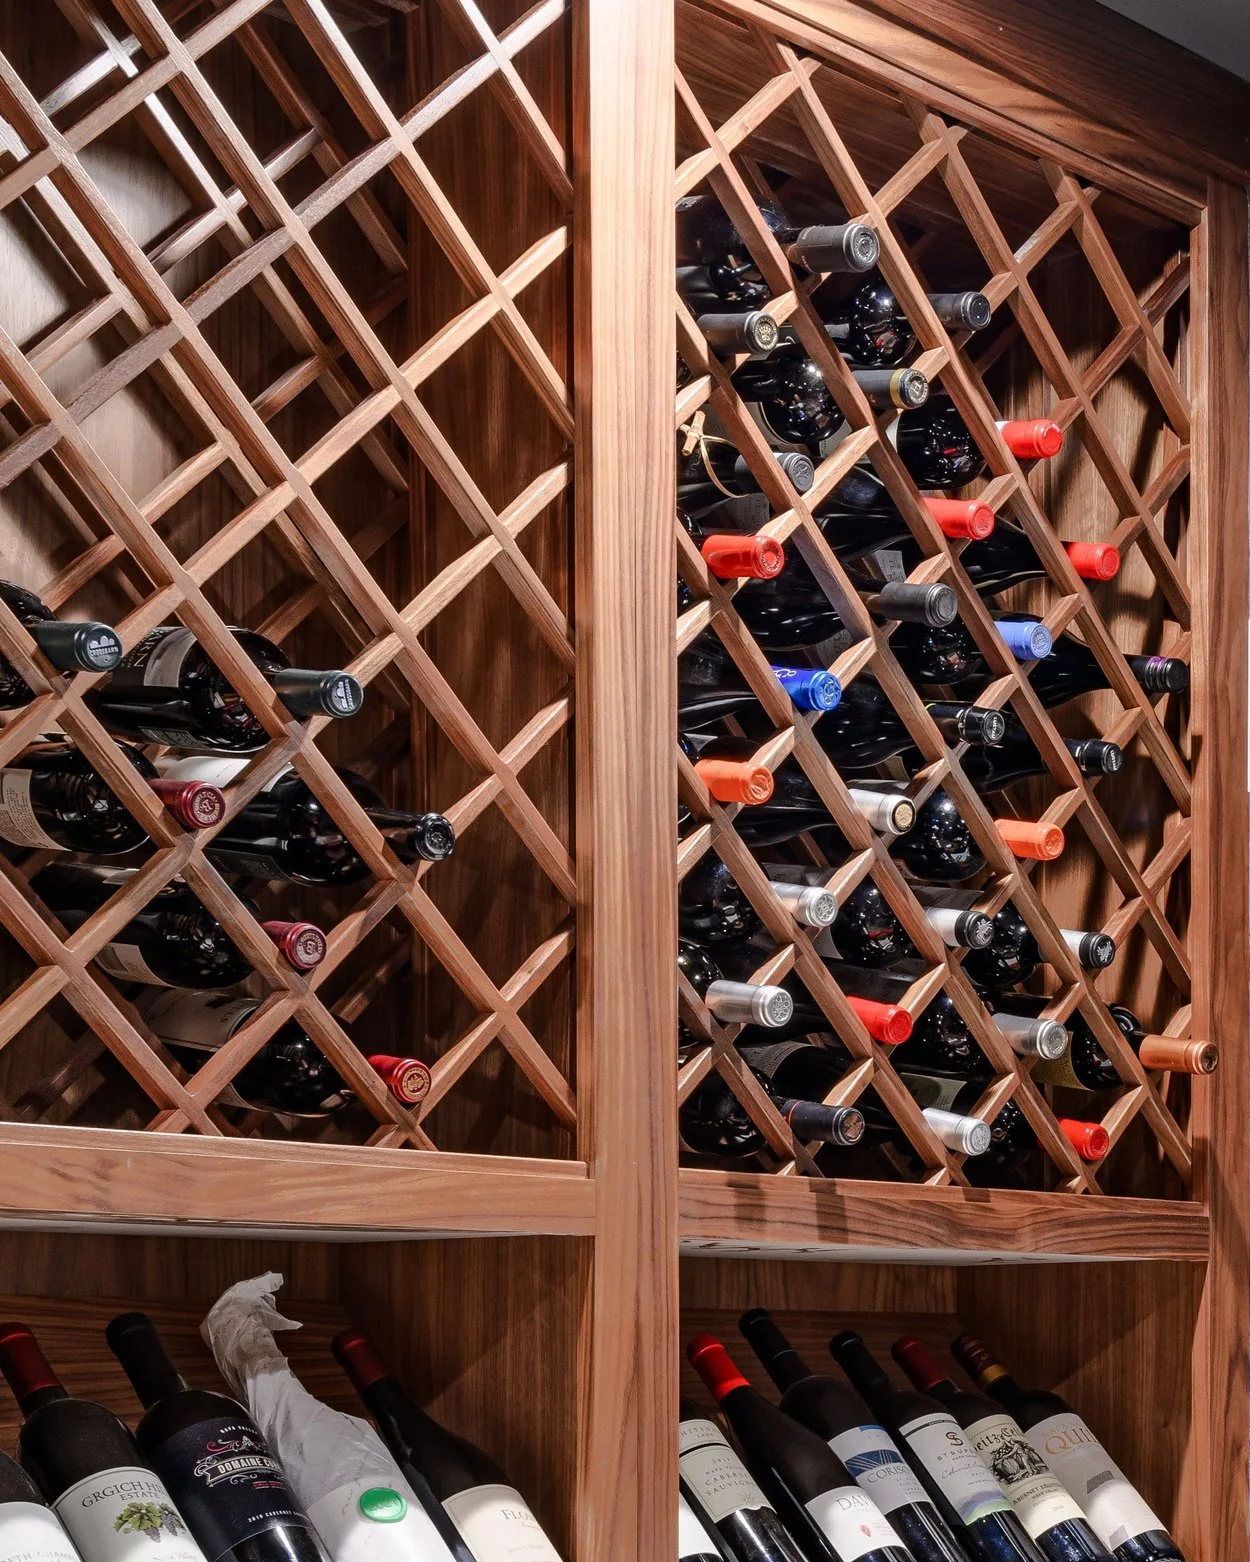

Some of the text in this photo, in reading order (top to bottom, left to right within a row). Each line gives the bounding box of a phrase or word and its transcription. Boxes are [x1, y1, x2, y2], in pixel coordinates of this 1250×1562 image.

[217, 1457, 264, 1475] DOMAINE
[81, 1481, 144, 1508] GRGICH
[120, 1491, 161, 1501] ESTATE
[1012, 1486, 1040, 1506] ABERNET
